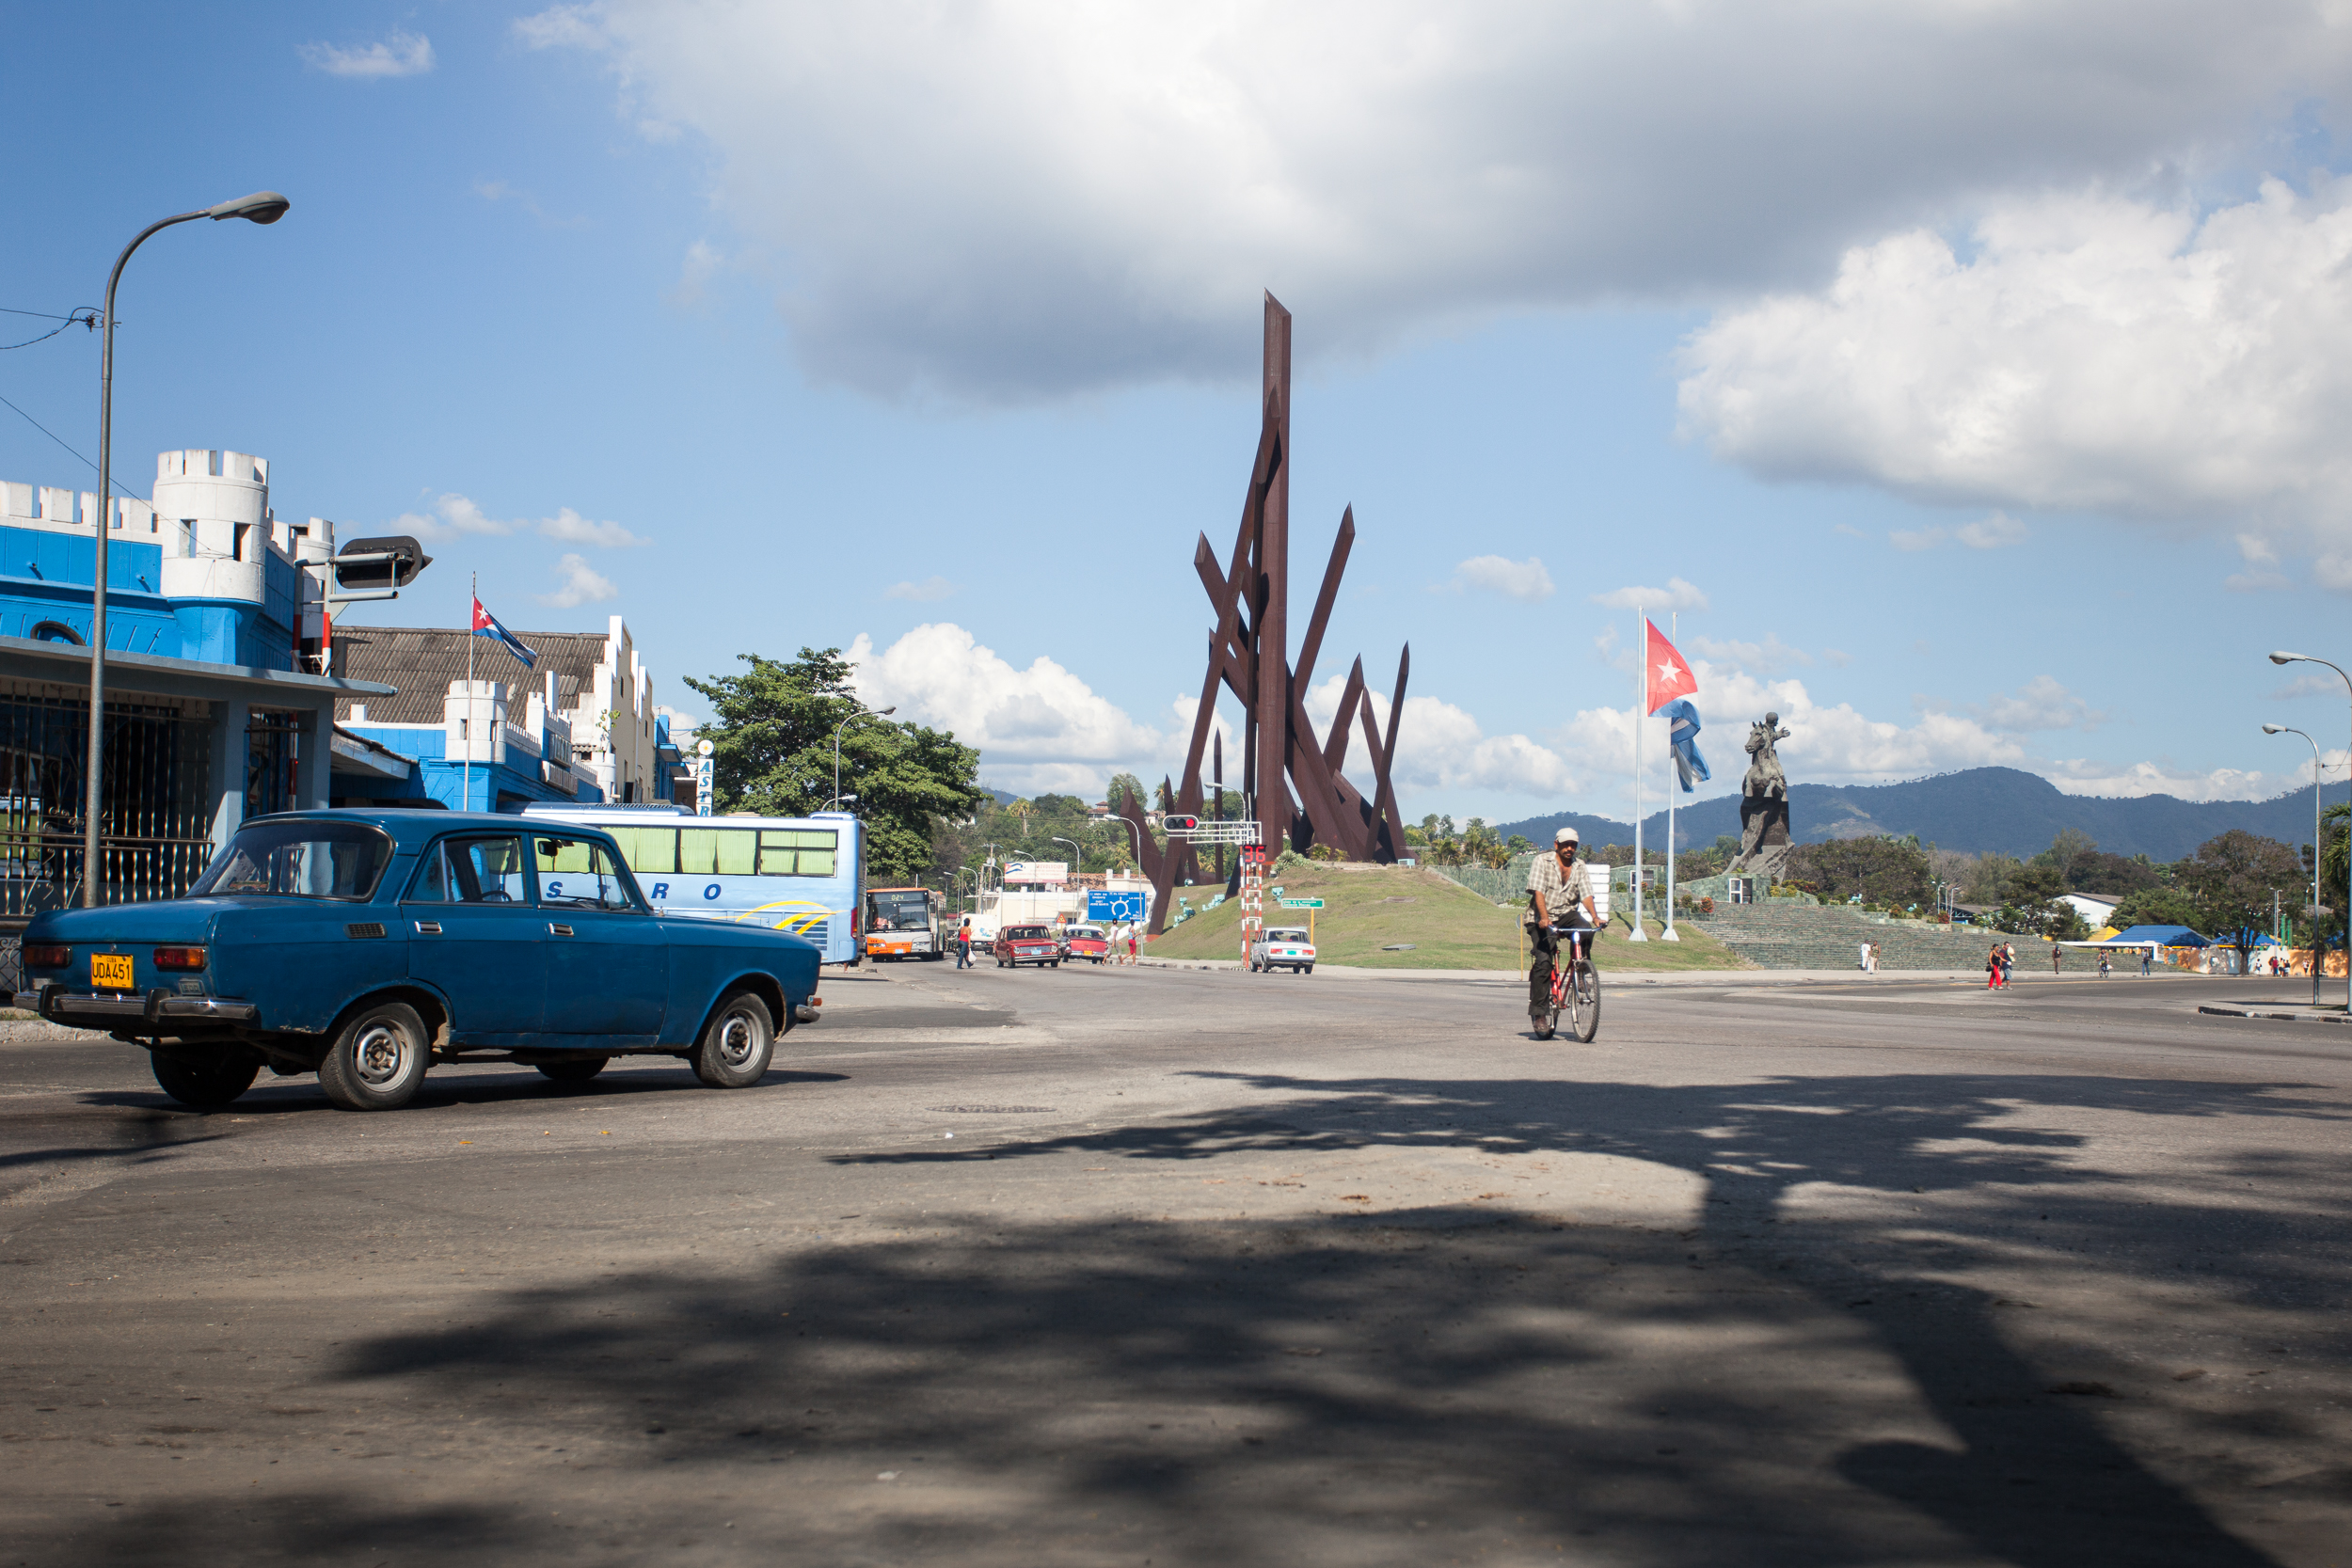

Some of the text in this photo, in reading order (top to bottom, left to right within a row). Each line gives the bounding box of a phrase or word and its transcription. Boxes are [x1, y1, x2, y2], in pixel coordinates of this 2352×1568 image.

[699, 760, 712, 817] ASTR
[1245, 846, 1265, 863] 36
[92, 962, 130, 980] UDA451
